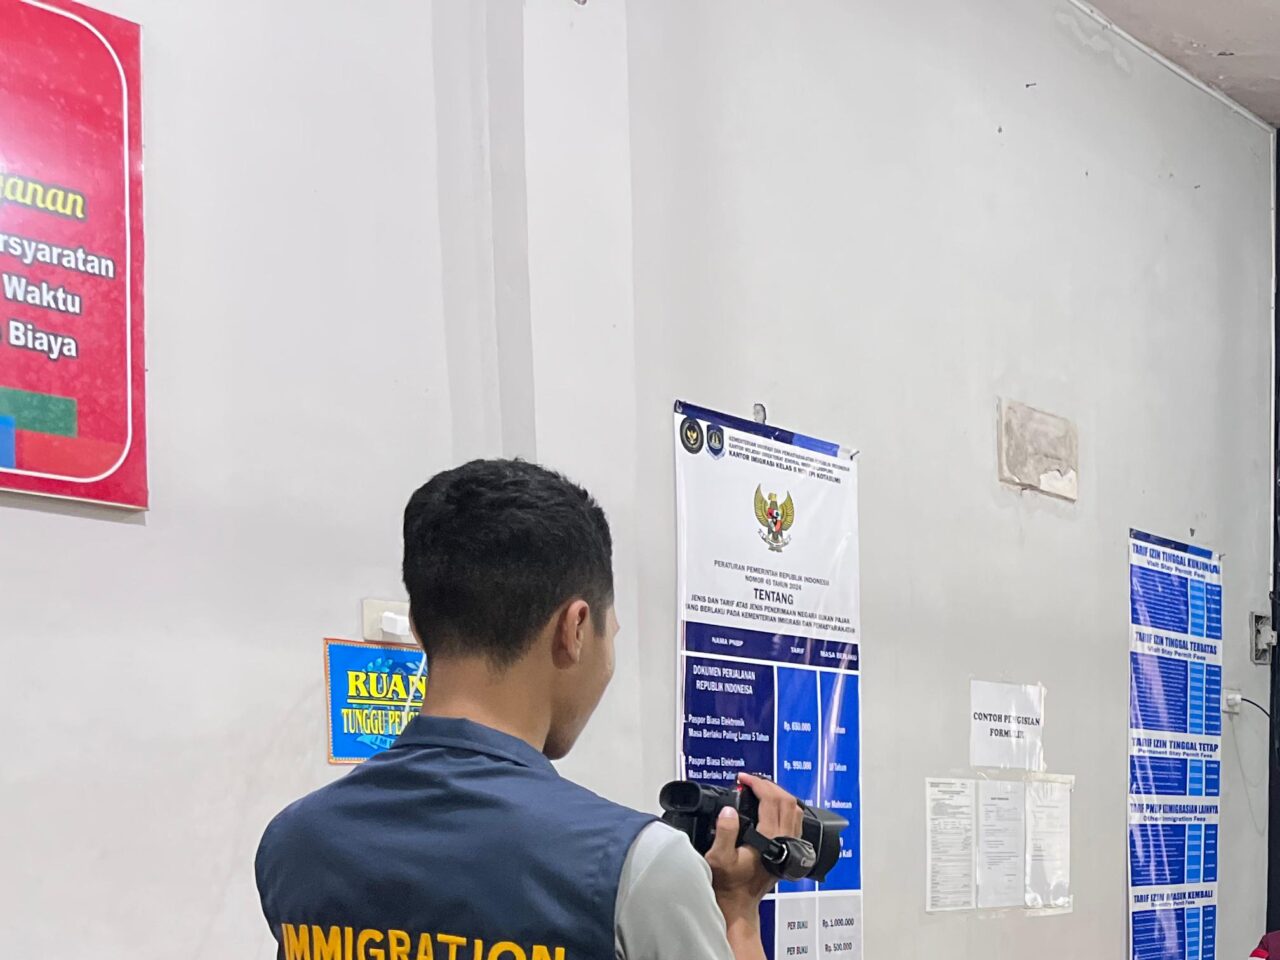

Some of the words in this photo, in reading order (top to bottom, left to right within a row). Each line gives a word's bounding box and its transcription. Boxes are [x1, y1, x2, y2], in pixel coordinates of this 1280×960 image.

[0, 176, 84, 218] anan
[2, 273, 81, 314] Waktu
[9, 320, 77, 359] Biaya
[714, 560, 745, 571] PERATURAN
[746, 565, 778, 578] PEMERINTAH
[691, 594, 706, 603] JENIS
[707, 596, 719, 605] DAN
[720, 598, 735, 607] TARIF
[736, 601, 748, 609] ATAS
[753, 588, 794, 605] TENTANG
[700, 605, 725, 615] BERLAKU
[726, 608, 740, 617] PADA
[693, 664, 721, 677] DOKUMEN
[721, 667, 756, 680] PERJALANAN
[696, 680, 724, 692] REPUBLIK
[341, 708, 385, 735] TUNGGU
[688, 714, 706, 725] Paspor
[706, 715, 720, 725] Biasa
[721, 716, 745, 727] Elektronik
[973, 712, 1002, 723] CONTOH
[1004, 714, 1040, 726] PEGISIAN
[688, 728, 702, 738] Masa
[703, 728, 722, 739] Berlaku
[722, 730, 738, 742] Paling
[1153, 739, 1167, 749] IZIN
[1169, 740, 1197, 751] TINGGAL
[1199, 742, 1219, 752] TETAP
[688, 755, 706, 767] Paspor
[706, 756, 720, 766] Biasa
[721, 757, 745, 767] Elektronik
[688, 769, 702, 779] Masa
[703, 770, 722, 780] Berlaku
[722, 770, 737, 781] Palin
[1187, 890, 1213, 899] KEMBALI
